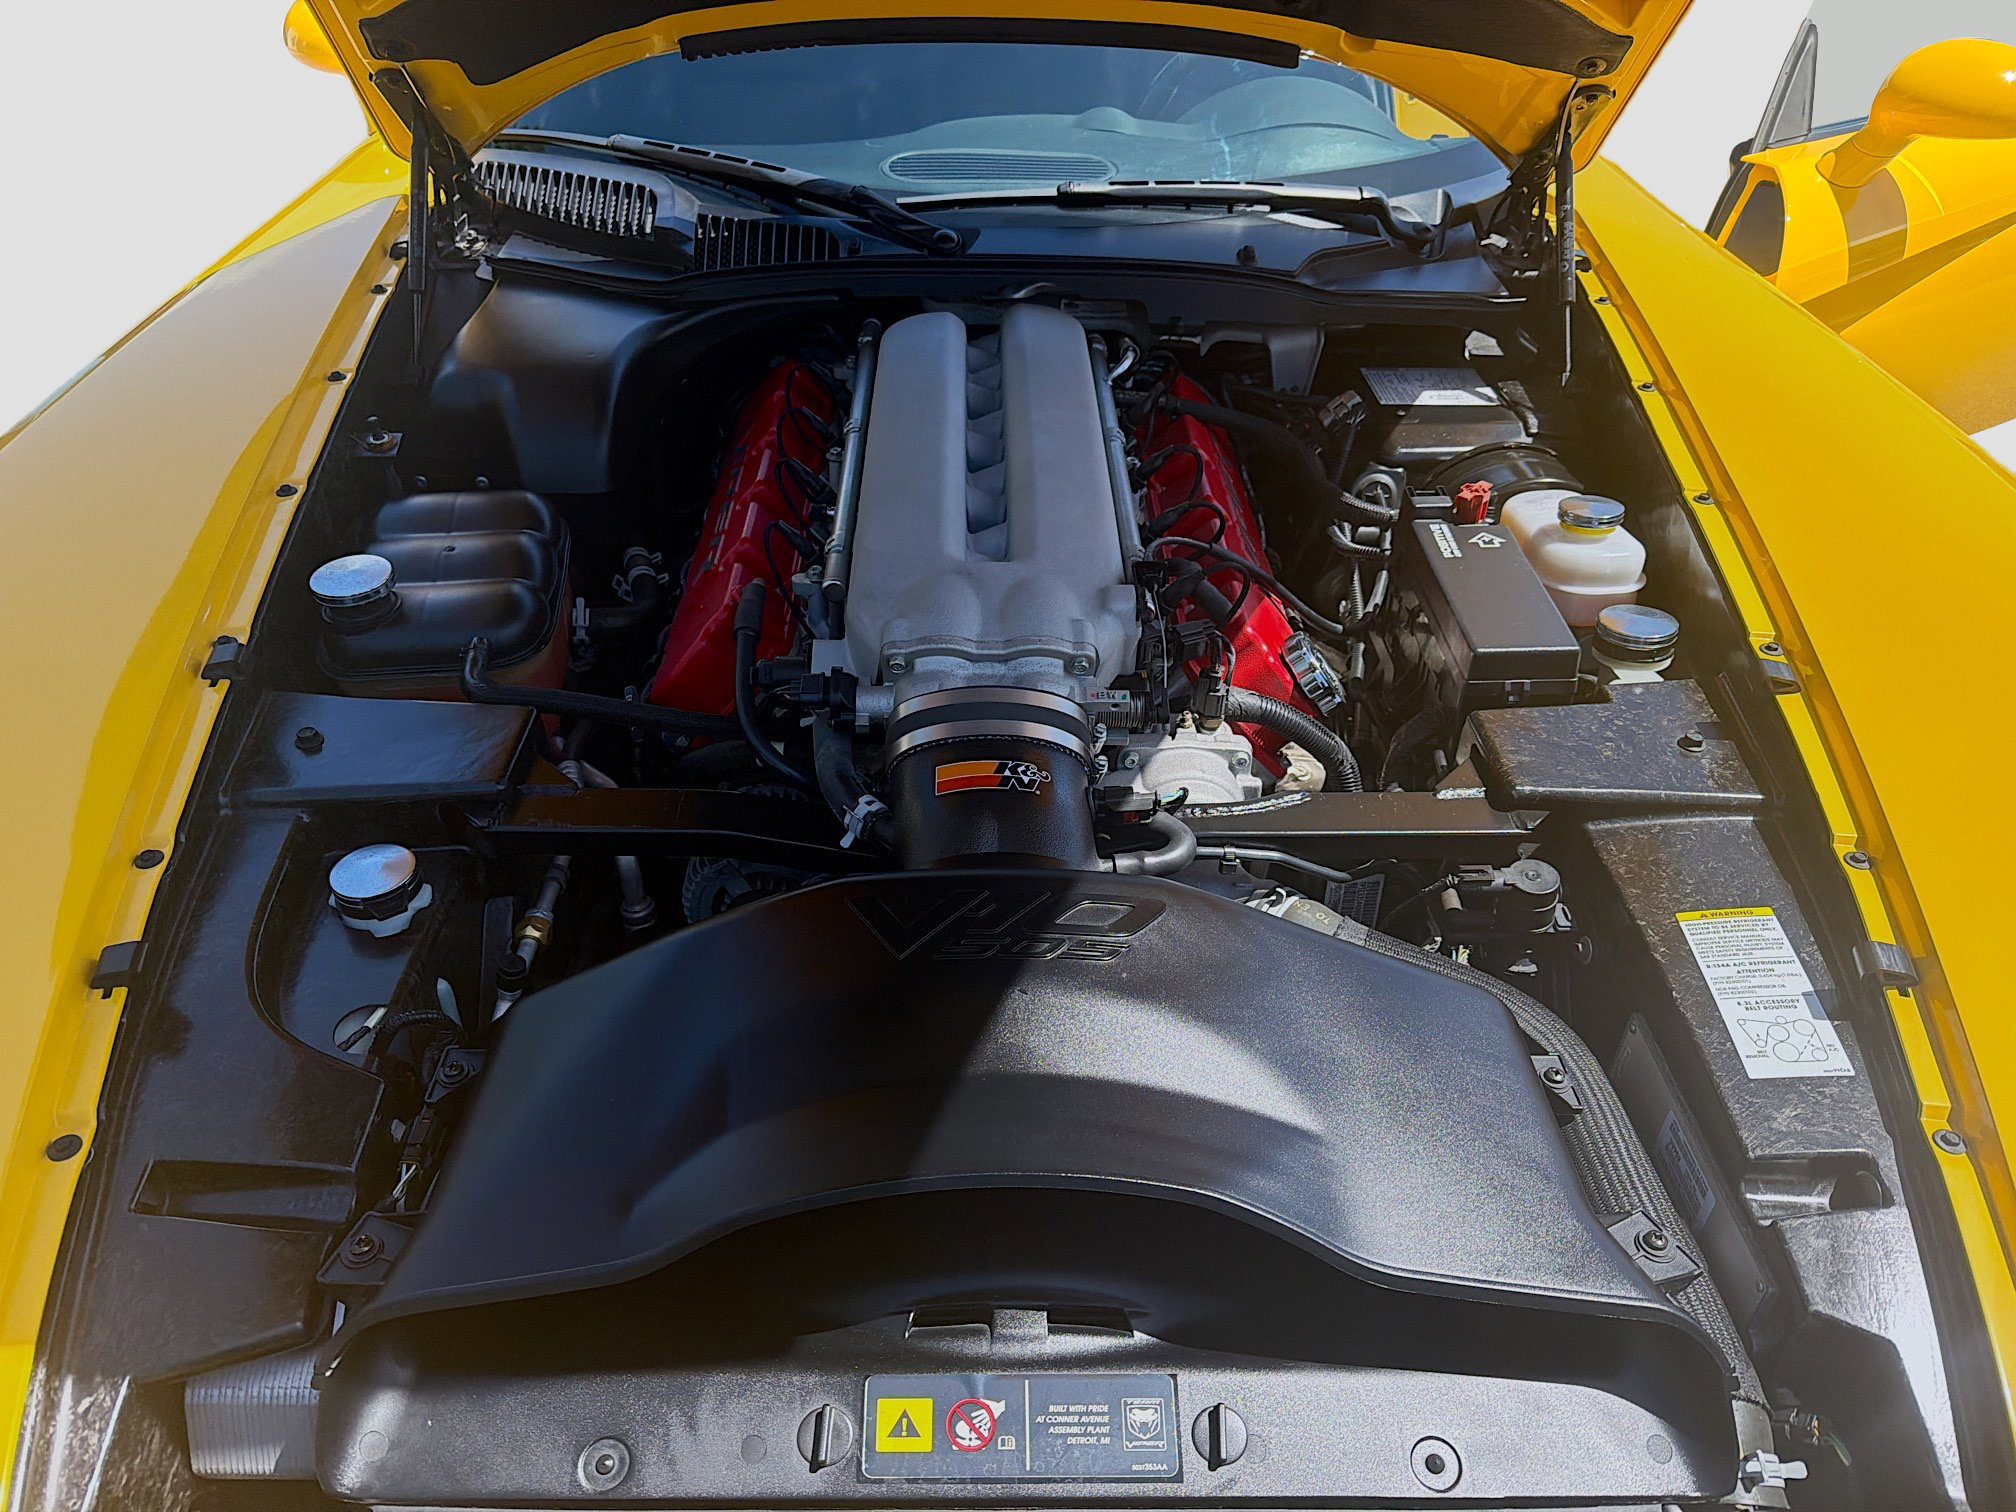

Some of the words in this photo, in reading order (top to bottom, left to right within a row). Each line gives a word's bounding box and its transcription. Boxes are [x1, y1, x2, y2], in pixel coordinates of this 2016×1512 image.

[1429, 523, 1455, 559] POSITIVE
[1315, 912, 1331, 925] TO
[931, 937, 1132, 962] 505
[1048, 1404, 1069, 1413] BUILT
[1068, 1404, 1087, 1413] WITH
[1088, 1404, 1110, 1414] PRIDE
[1035, 1415, 1046, 1424] AT
[1046, 1415, 1079, 1424] CONNER
[1080, 1415, 1110, 1424] AVENUE
[1048, 1425, 1086, 1434] ASSEMBLY
[1087, 1425, 1111, 1434] PLANT
[1066, 1436, 1099, 1446] DETROIT,
[1100, 1436, 1111, 1445] MI
[1125, 1440, 1166, 1449] VIPER
